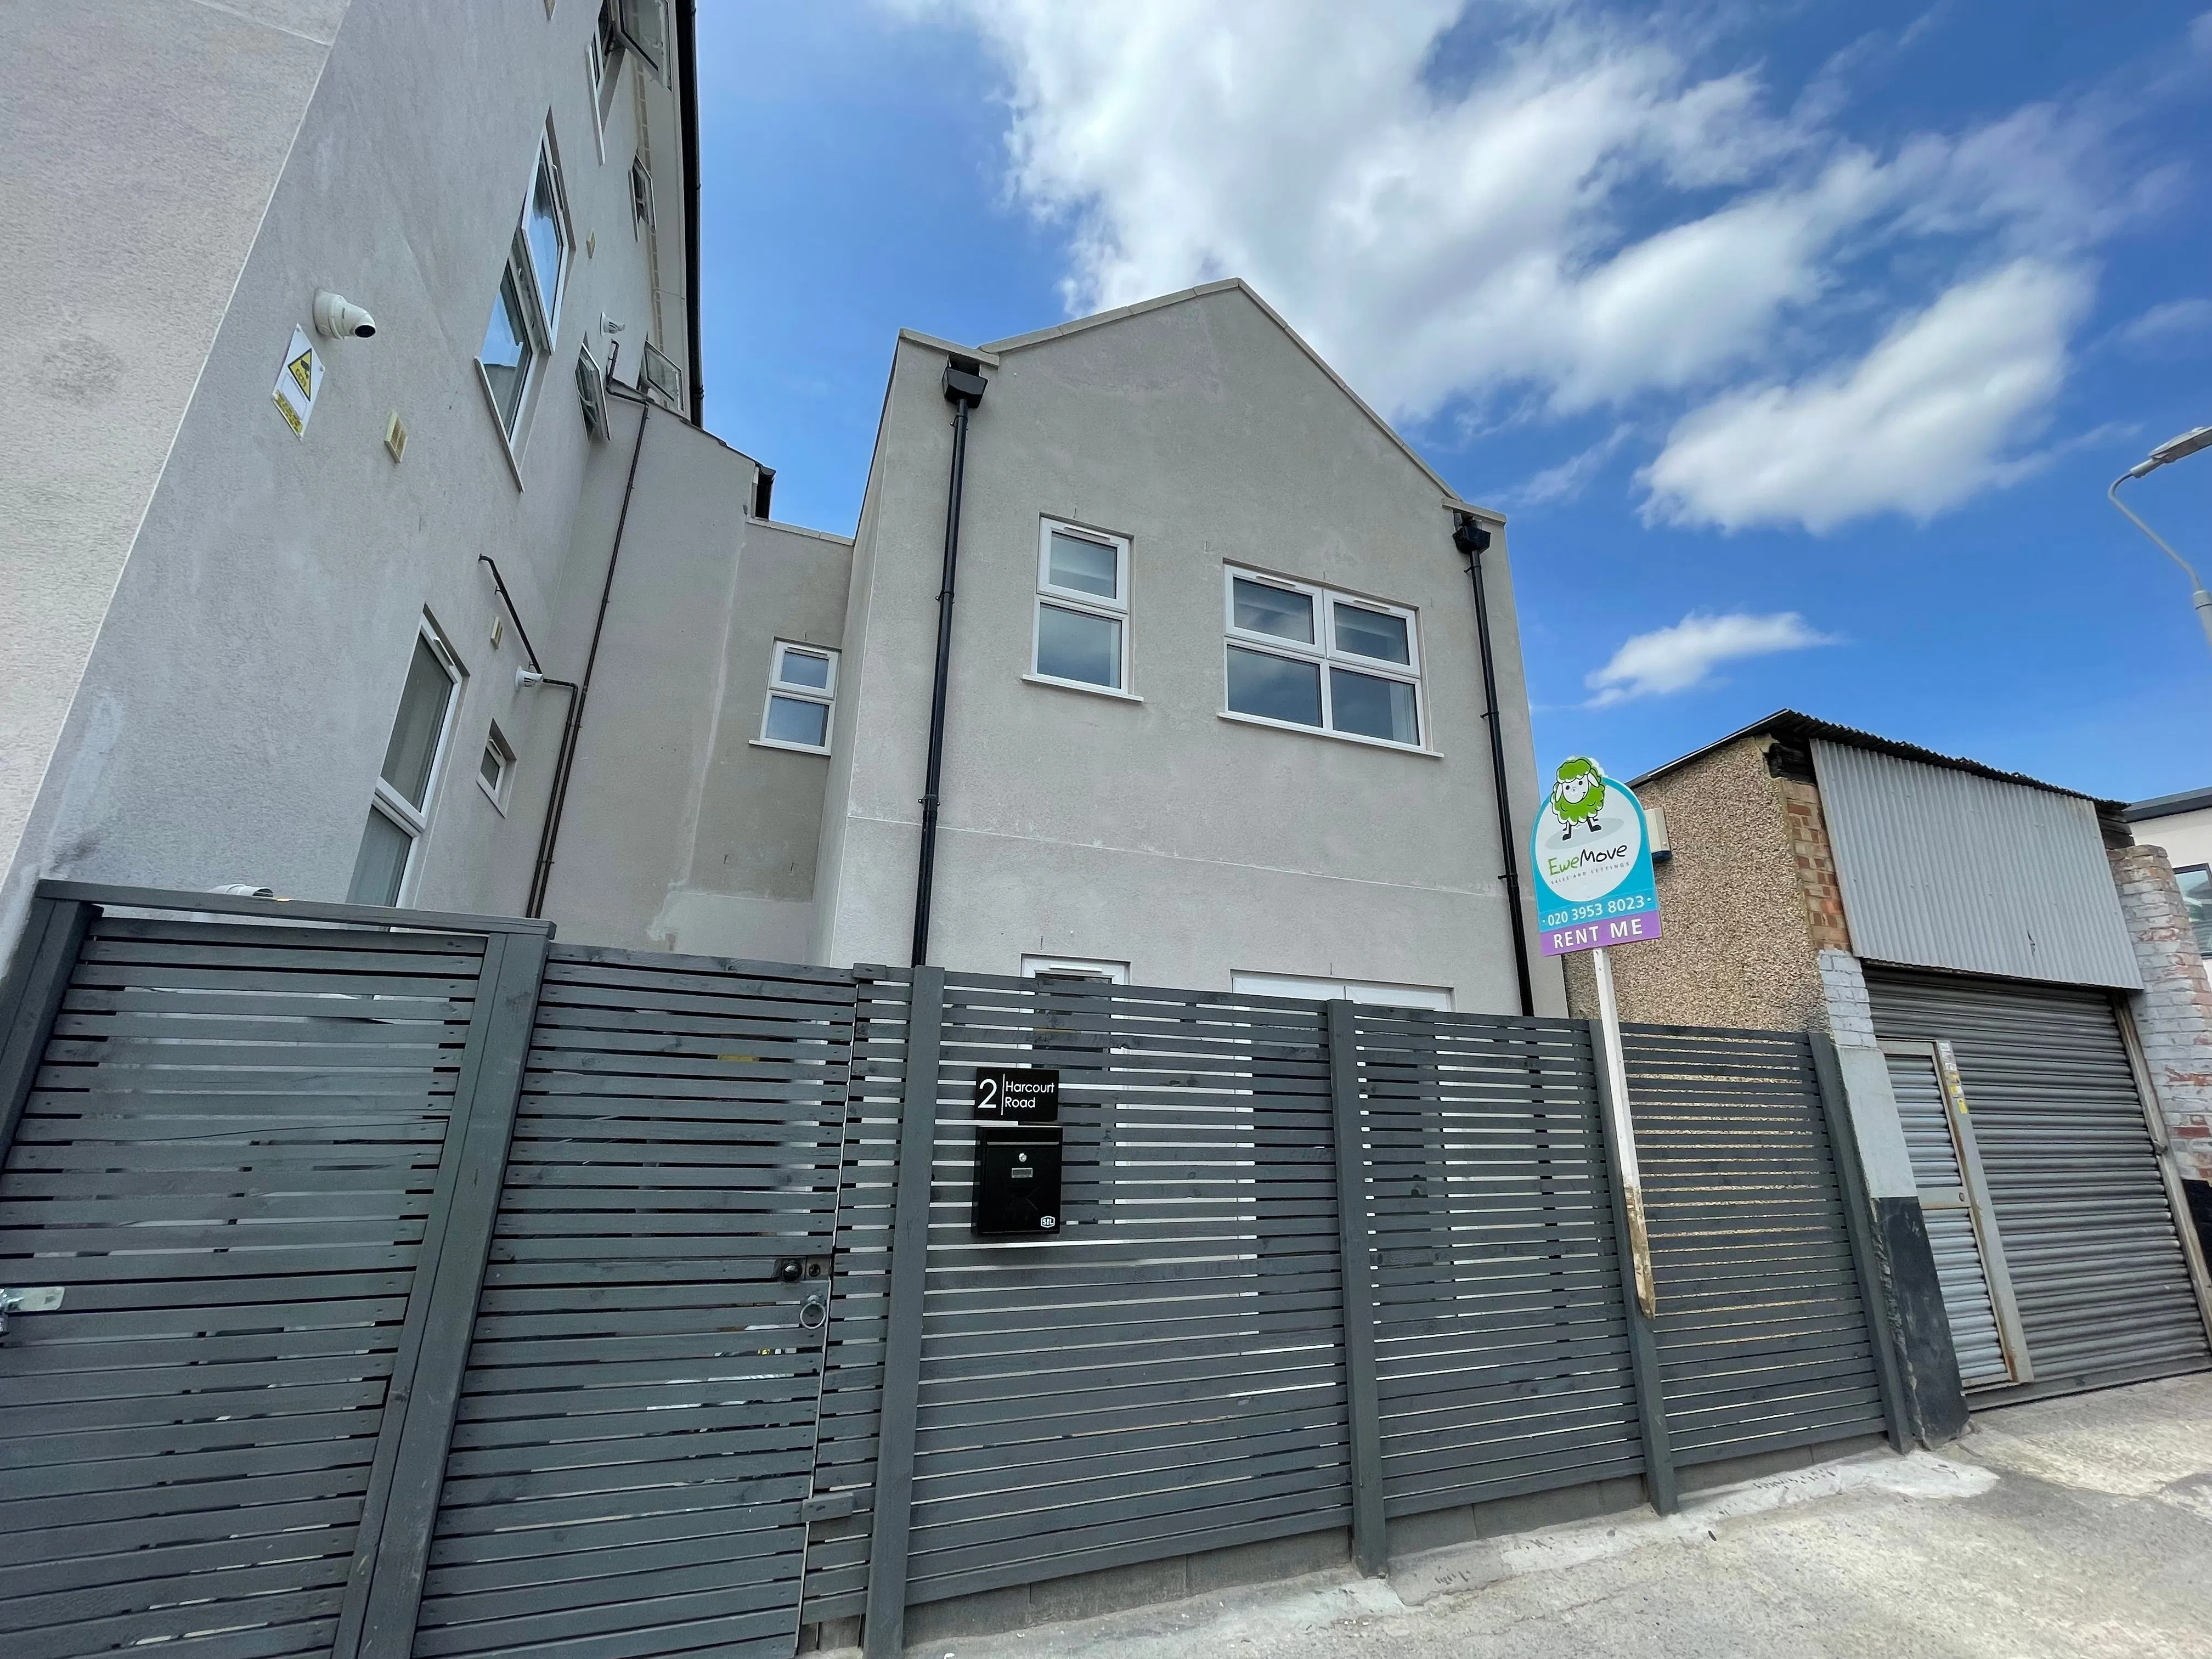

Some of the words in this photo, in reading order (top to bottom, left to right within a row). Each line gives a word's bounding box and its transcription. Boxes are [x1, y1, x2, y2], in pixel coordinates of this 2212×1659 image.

[295, 368, 307, 387] CCTV
[1548, 845, 1628, 876] EweMove
[1551, 876, 1570, 885] SALES
[1590, 861, 1630, 874] LETTINGS
[1547, 911, 1568, 927] 020
[1571, 903, 1603, 921] 3953
[1607, 895, 1645, 913] 8023
[1553, 926, 1599, 949] RENT
[1610, 918, 1643, 939] ME
[978, 1079, 997, 1108] 2
[1005, 1081, 1055, 1093] Harcourt
[1005, 1096, 1036, 1108] Road
